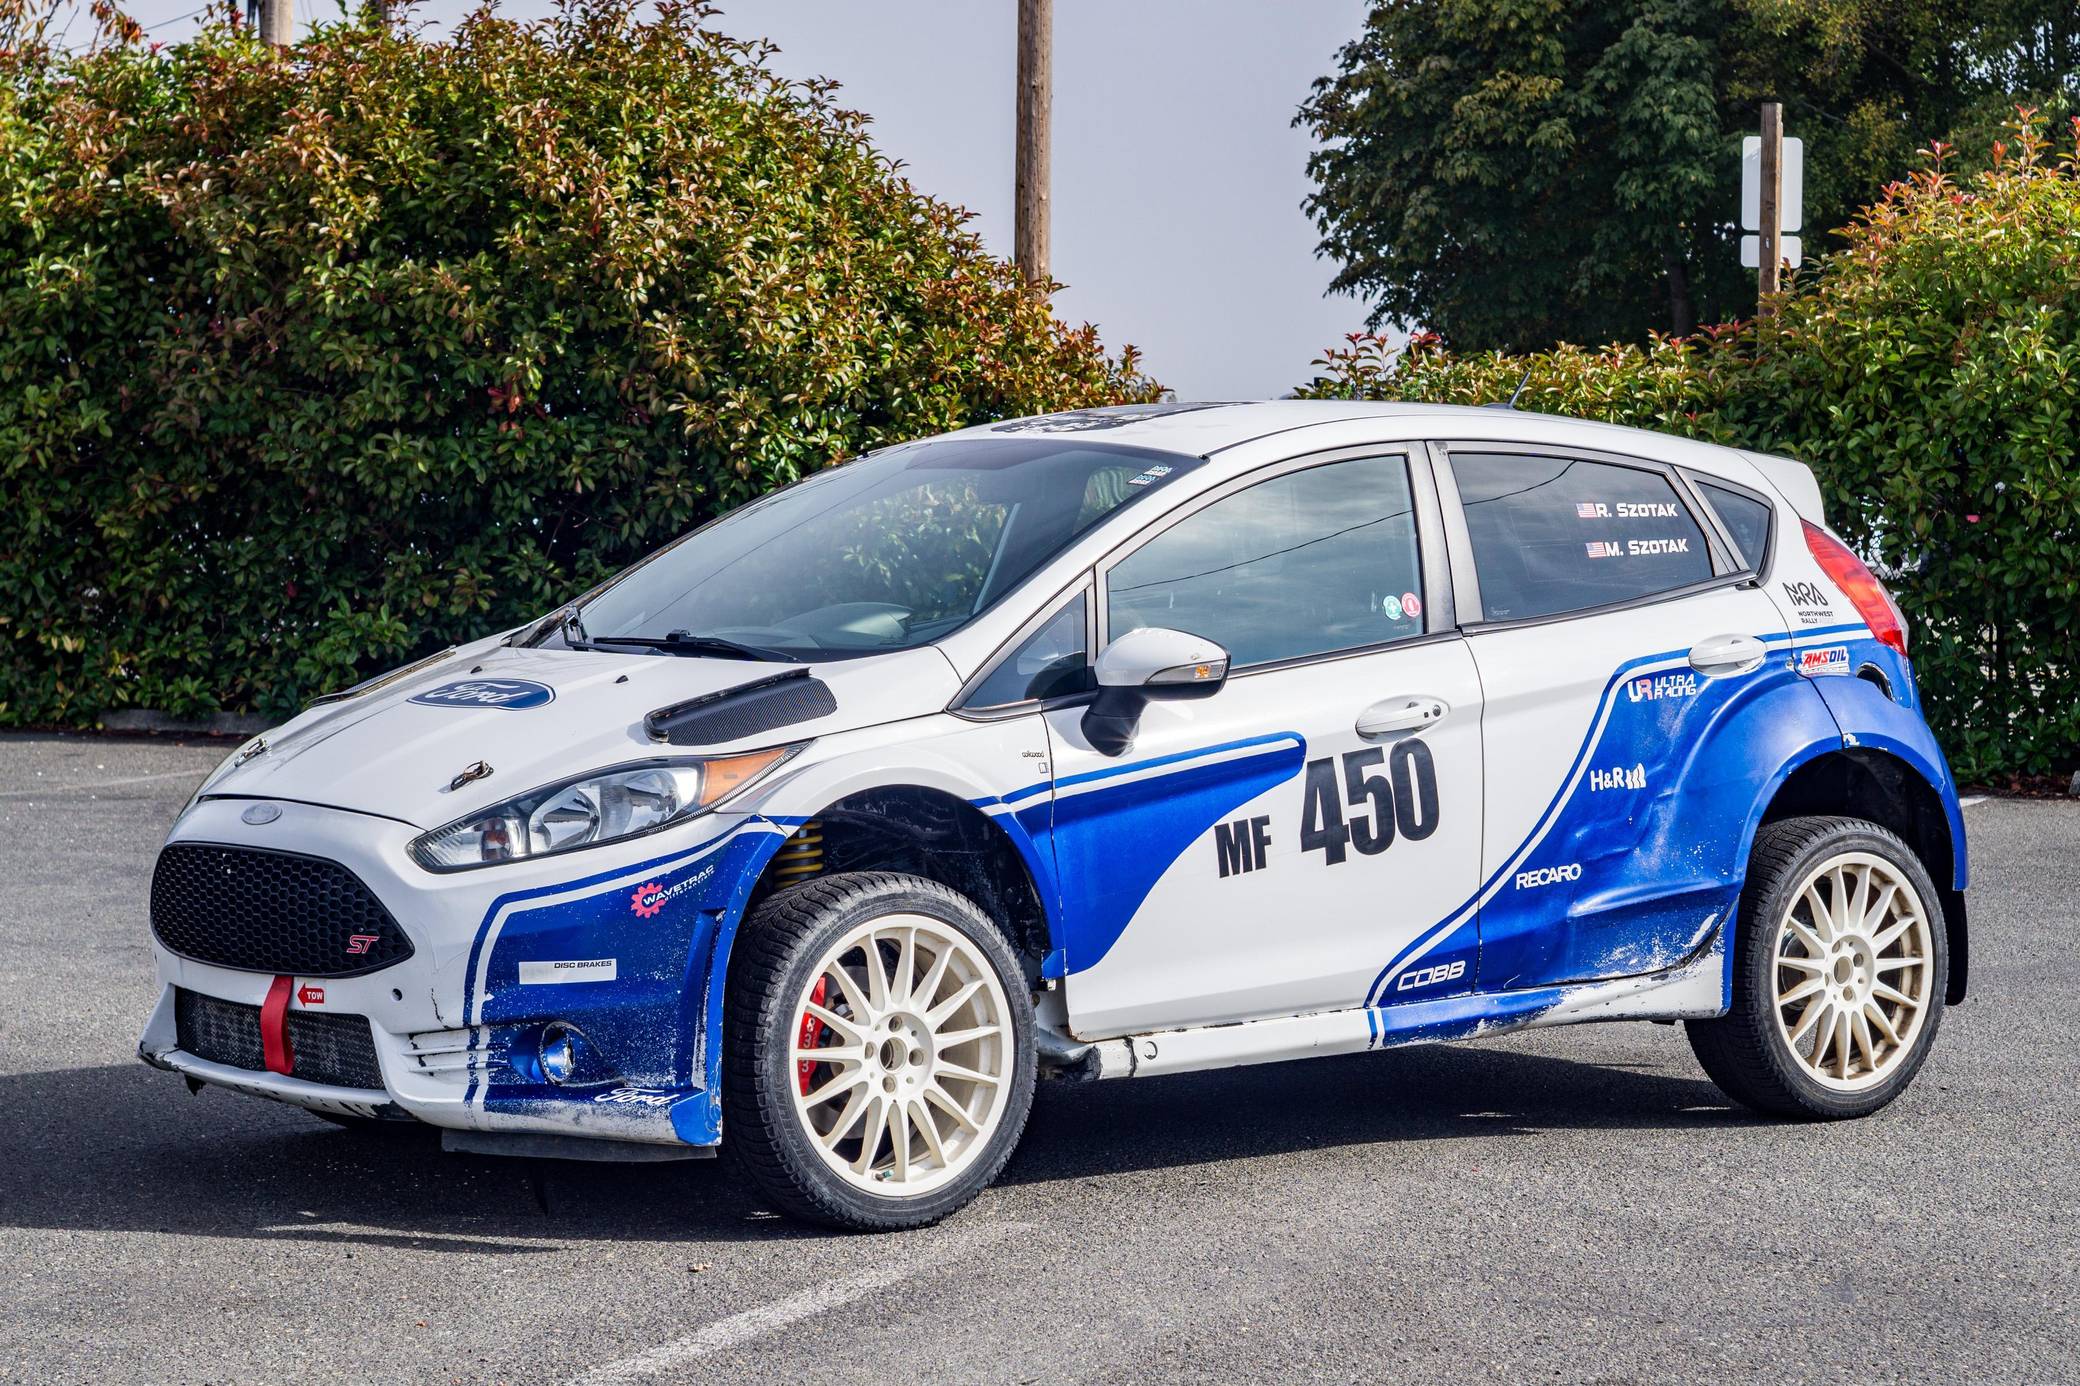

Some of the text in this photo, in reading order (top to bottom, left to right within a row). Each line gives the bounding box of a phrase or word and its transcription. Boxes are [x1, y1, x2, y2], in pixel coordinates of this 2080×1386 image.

[1595, 503, 1678, 518] R. SZOTAK
[1604, 539, 1689, 557] M. SZOTAK
[1803, 649, 1847, 667] AMSOIL
[1654, 674, 1696, 689] ULTRA
[424, 682, 532, 703] Ford
[1654, 684, 1697, 700] RACING
[1590, 767, 1625, 791] H&R
[1300, 737, 1440, 866] 450
[1214, 814, 1272, 878] MF
[643, 864, 714, 905] WAVETRAC
[1516, 863, 1582, 890] RECARO
[346, 935, 380, 954] ST
[576, 960, 612, 969] BRAKES
[1397, 960, 1466, 991] COBB
[306, 990, 324, 1001] TOW
[594, 1088, 680, 1105] Ford
